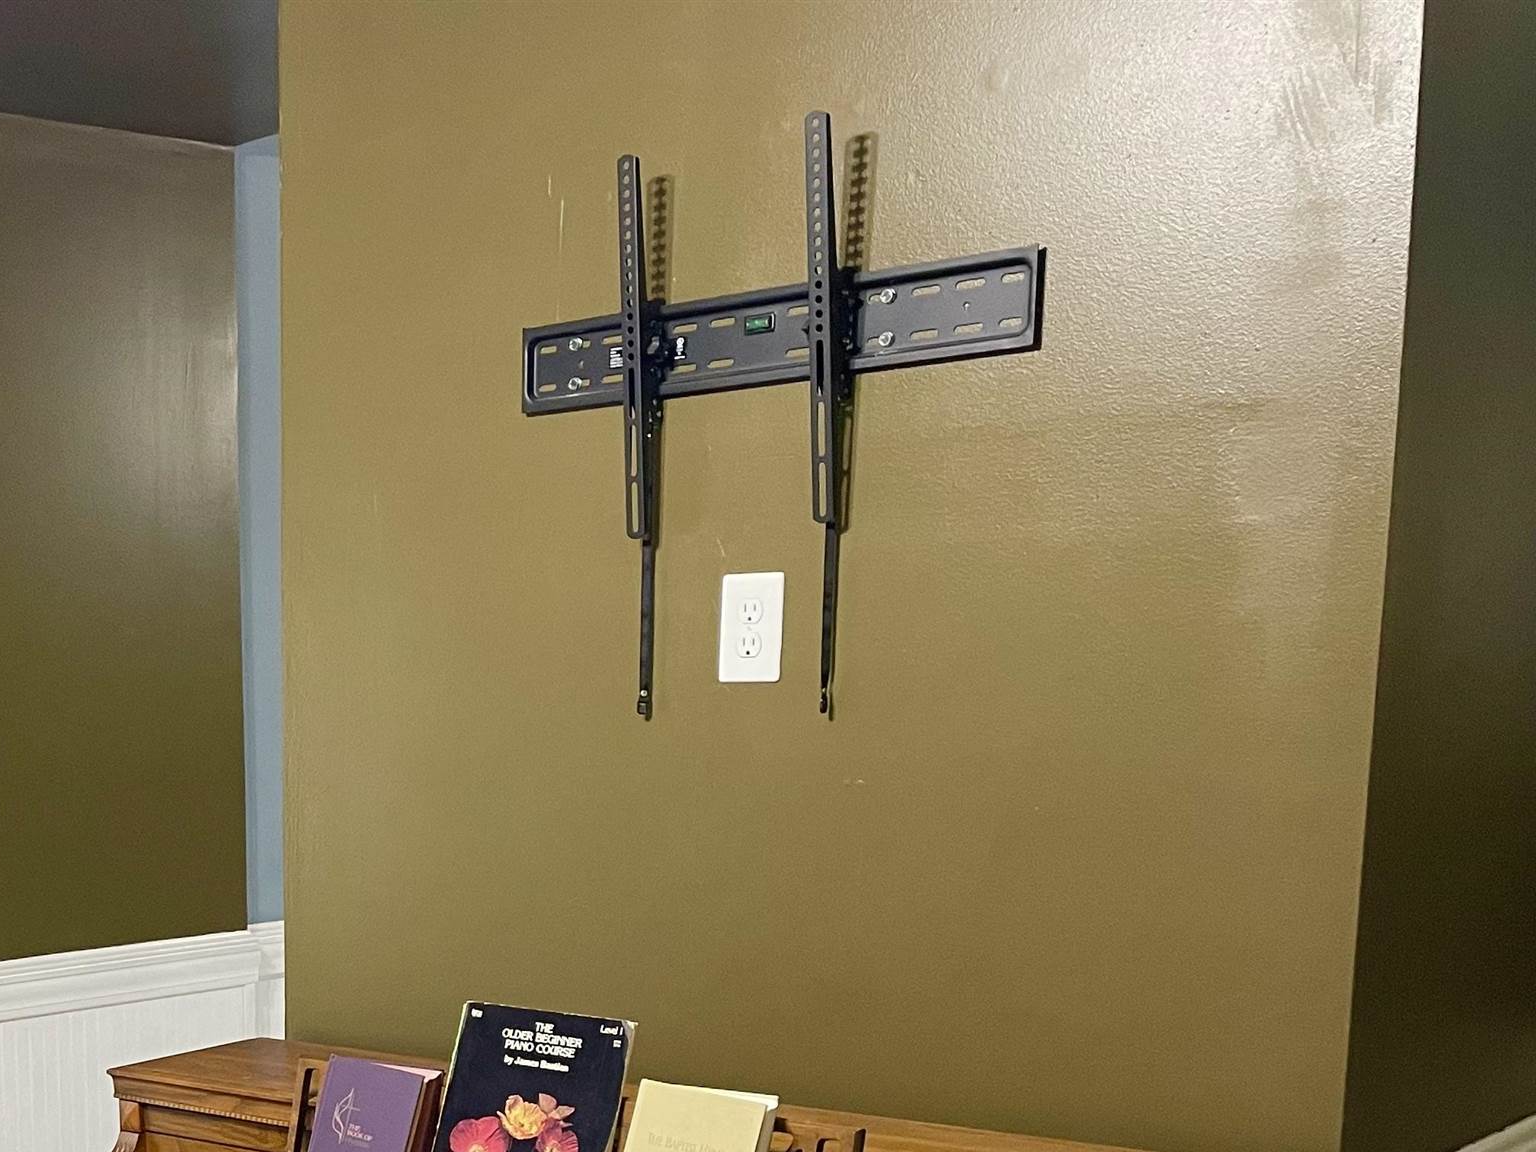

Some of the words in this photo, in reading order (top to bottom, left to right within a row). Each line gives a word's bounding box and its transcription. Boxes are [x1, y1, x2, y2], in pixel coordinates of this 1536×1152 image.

[535, 1021, 555, 1034] THE
[501, 1028, 534, 1041] OLDER
[535, 1032, 583, 1049] BEGINNER
[504, 1038, 535, 1053] PIANO
[535, 1043, 576, 1059] COURSE
